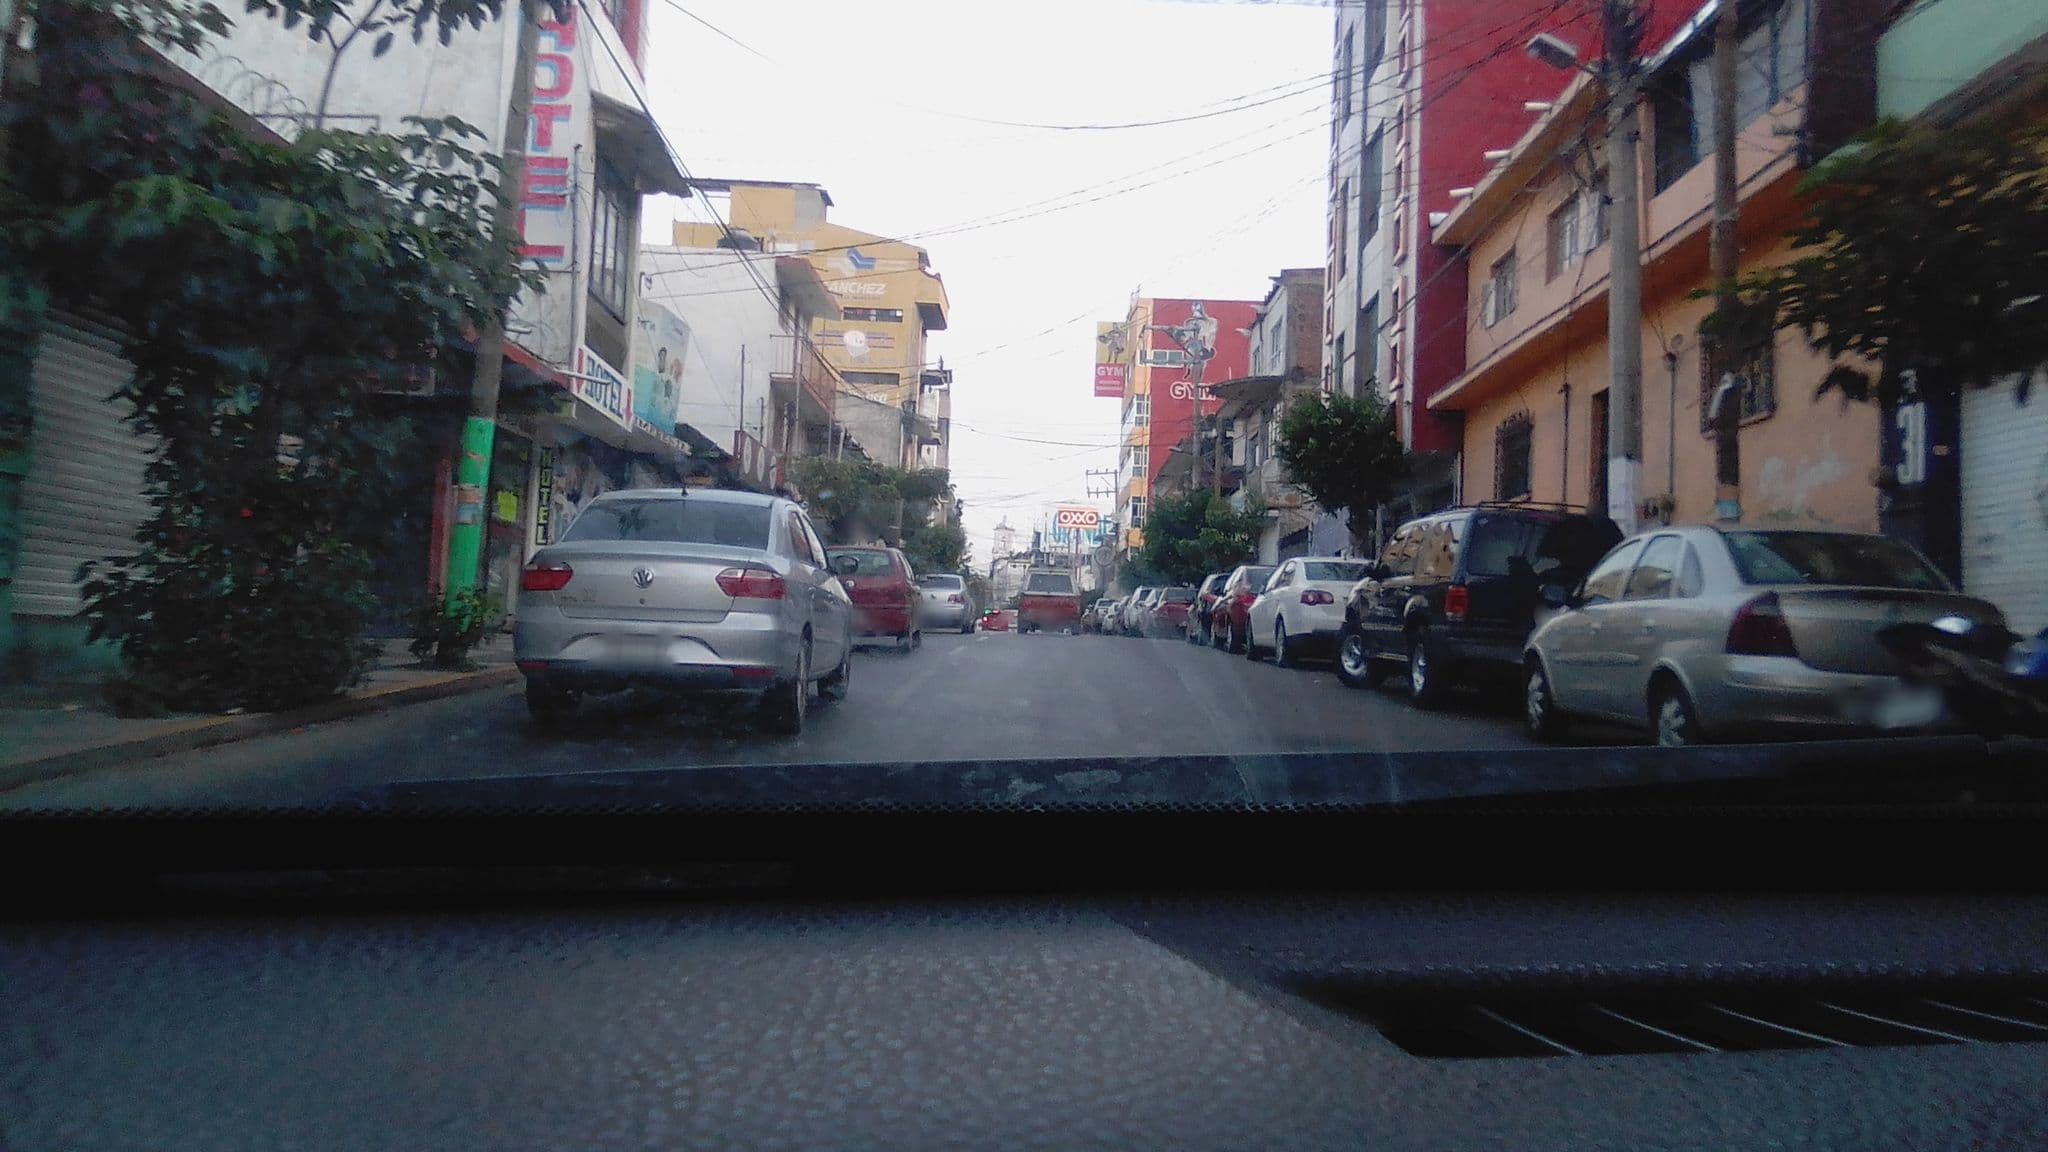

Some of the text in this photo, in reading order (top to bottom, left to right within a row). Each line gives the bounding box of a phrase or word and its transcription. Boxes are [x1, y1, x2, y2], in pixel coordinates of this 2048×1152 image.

[826, 281, 886, 295] ANCHEZ
[1097, 366, 1124, 377] GYM
[584, 355, 623, 419] HOTEL
[1059, 511, 1097, 524] OXXO
